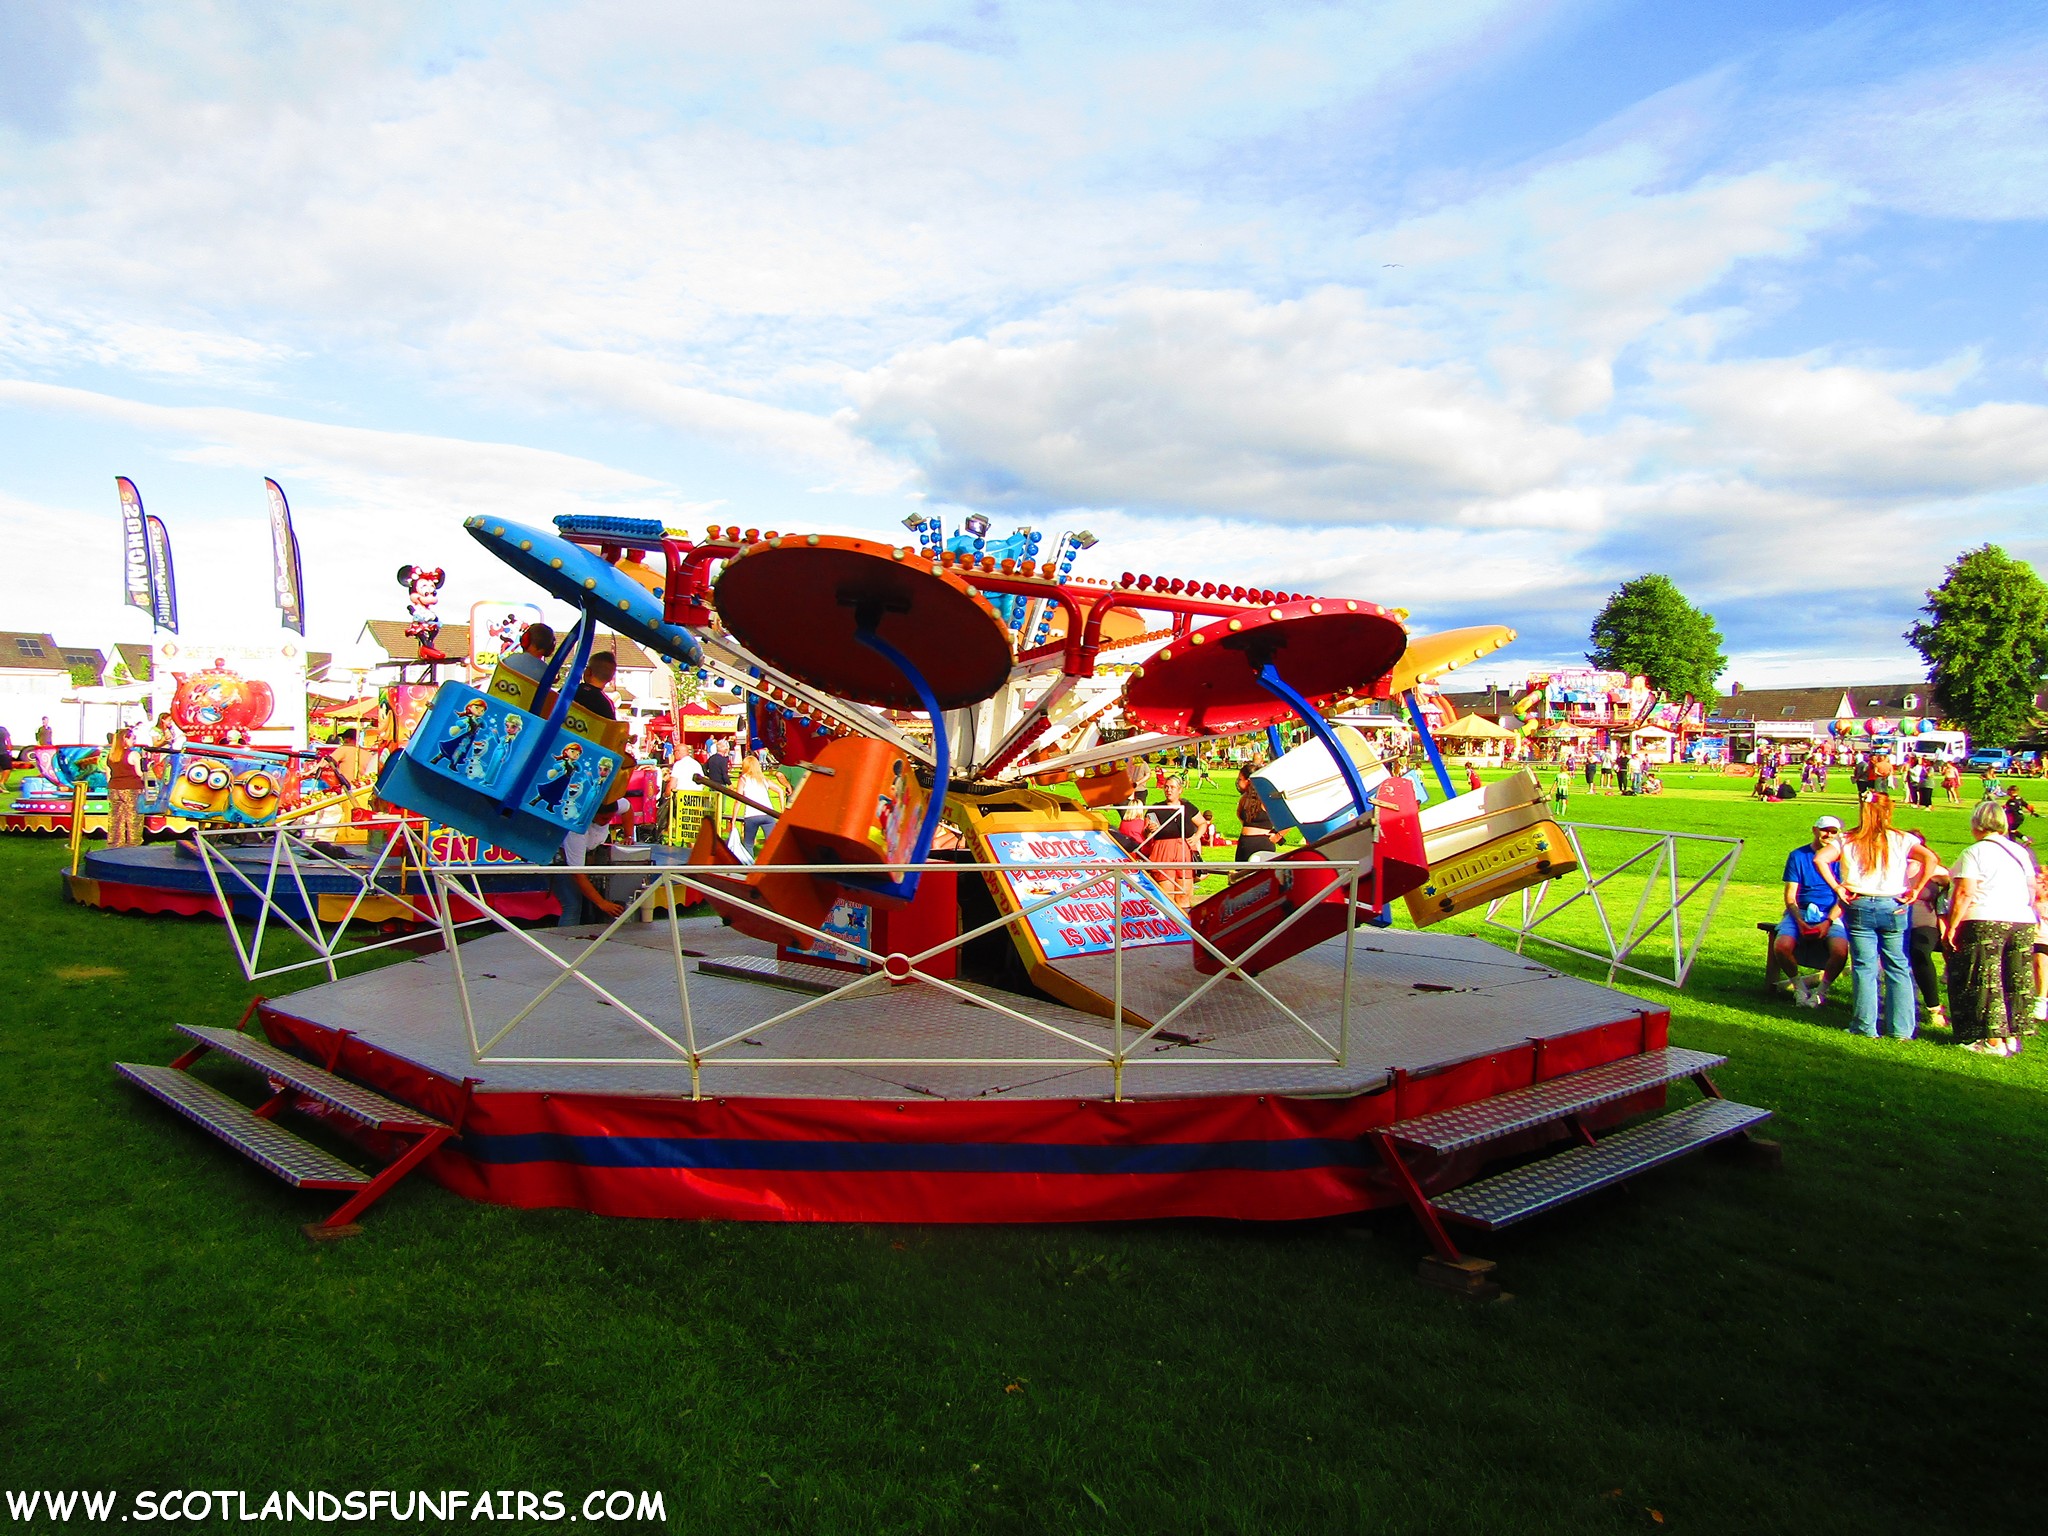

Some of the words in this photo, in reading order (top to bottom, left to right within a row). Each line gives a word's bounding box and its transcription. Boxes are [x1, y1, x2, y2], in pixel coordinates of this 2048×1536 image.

[476, 651, 498, 665] SKI
[684, 795, 701, 806] SAFETY
[430, 835, 478, 863] SKI
[1028, 839, 1097, 859] NOTICE
[1053, 901, 1117, 923] WHEN
[1058, 927, 1085, 947] IS
[1083, 924, 1114, 944] IN
